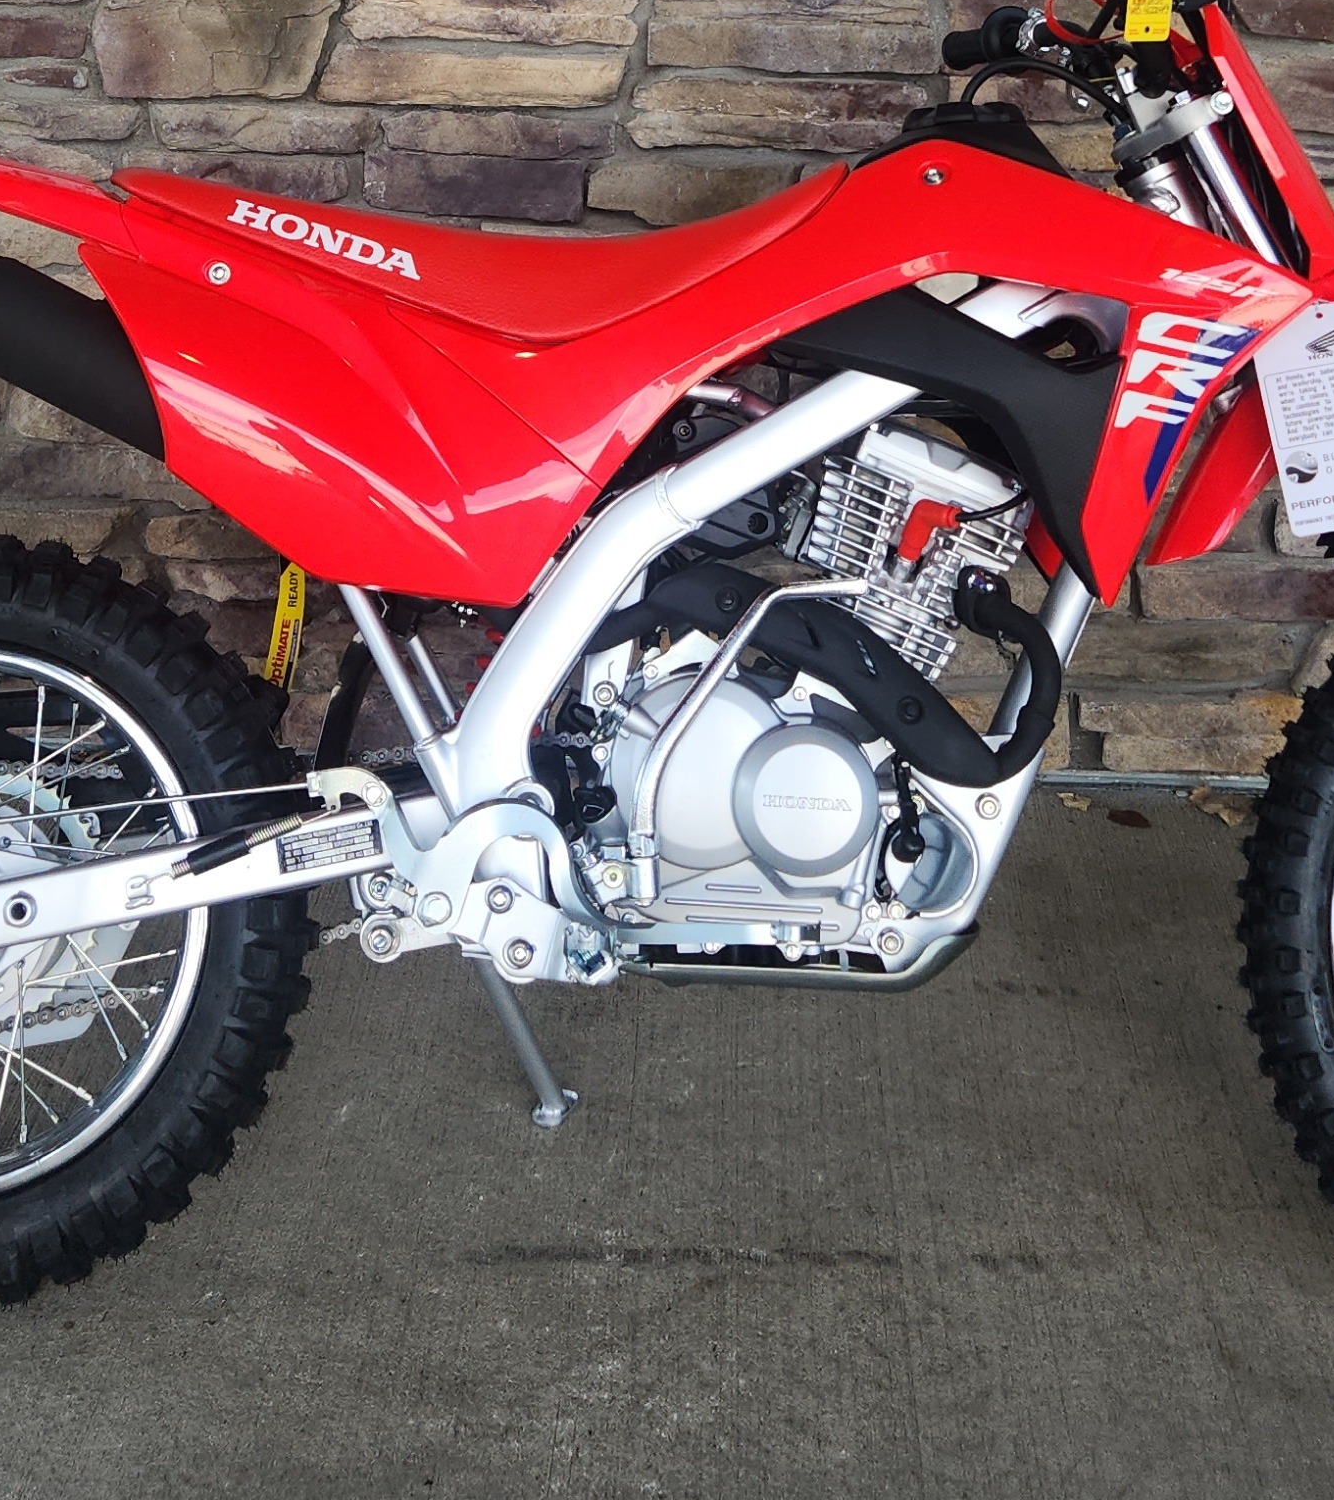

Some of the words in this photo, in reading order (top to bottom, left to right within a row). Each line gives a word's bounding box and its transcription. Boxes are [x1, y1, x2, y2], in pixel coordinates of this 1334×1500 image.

[226, 198, 421, 281] HONDA
[287, 570, 298, 608] READY
[762, 794, 852, 811] HONDA
